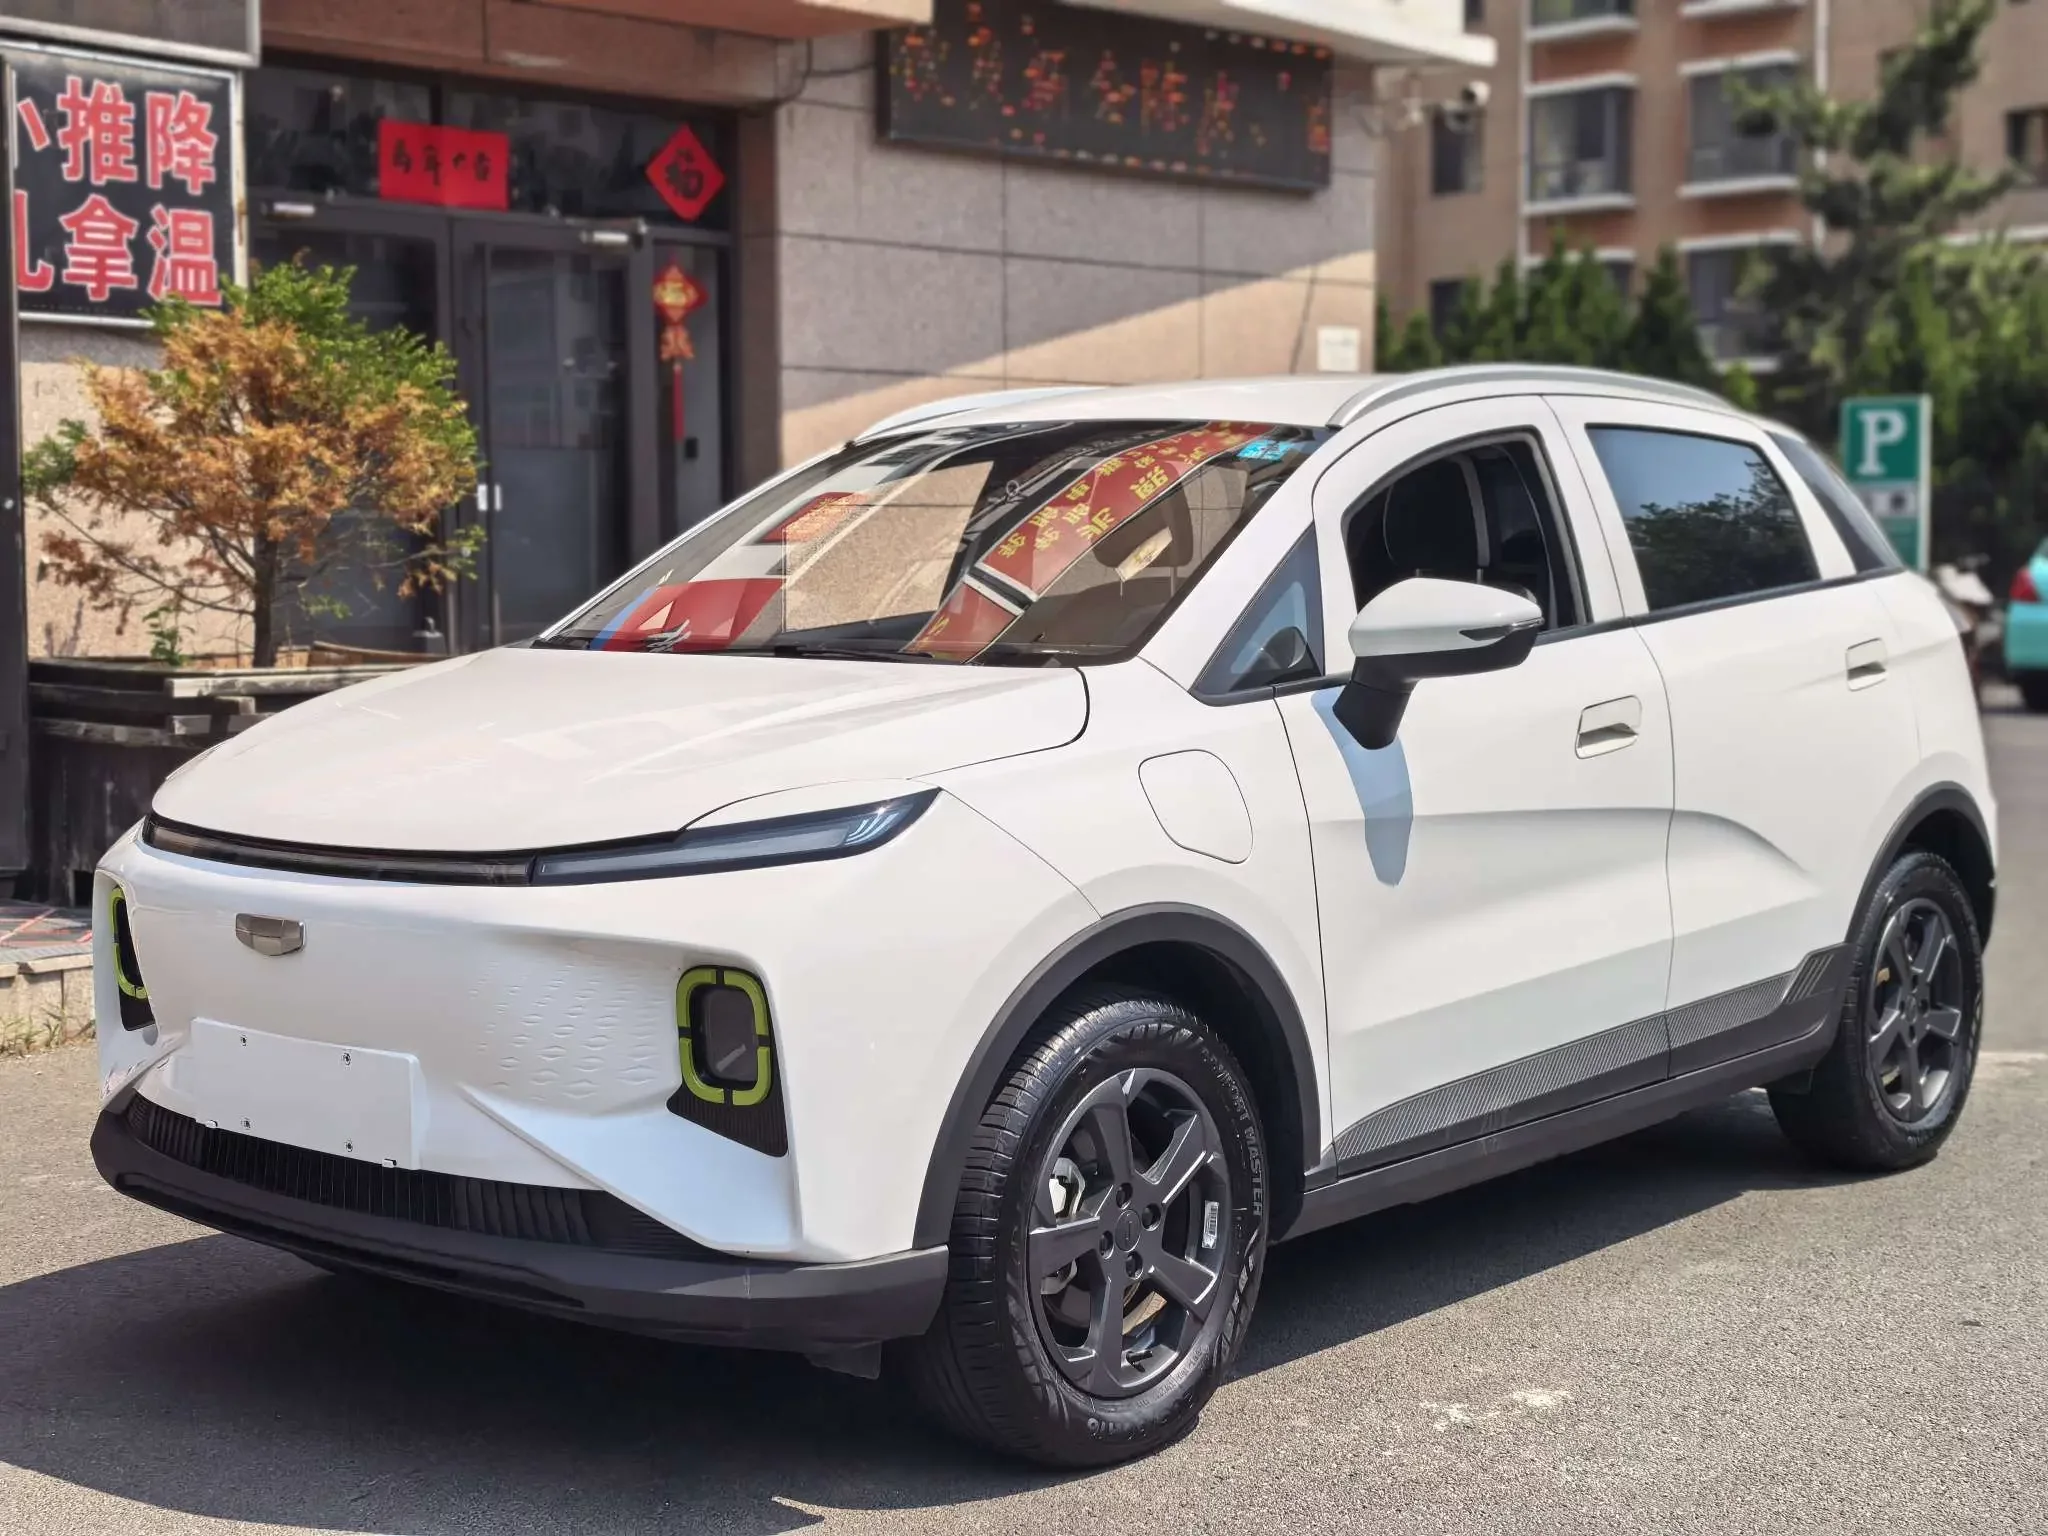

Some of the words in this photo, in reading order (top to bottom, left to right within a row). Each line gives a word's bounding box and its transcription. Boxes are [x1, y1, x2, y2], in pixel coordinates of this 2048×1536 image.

[56, 74, 140, 302] 推拿
[145, 89, 222, 306] 降温
[1856, 408, 1908, 476] P
[1244, 1124, 1264, 1216] MASTER
